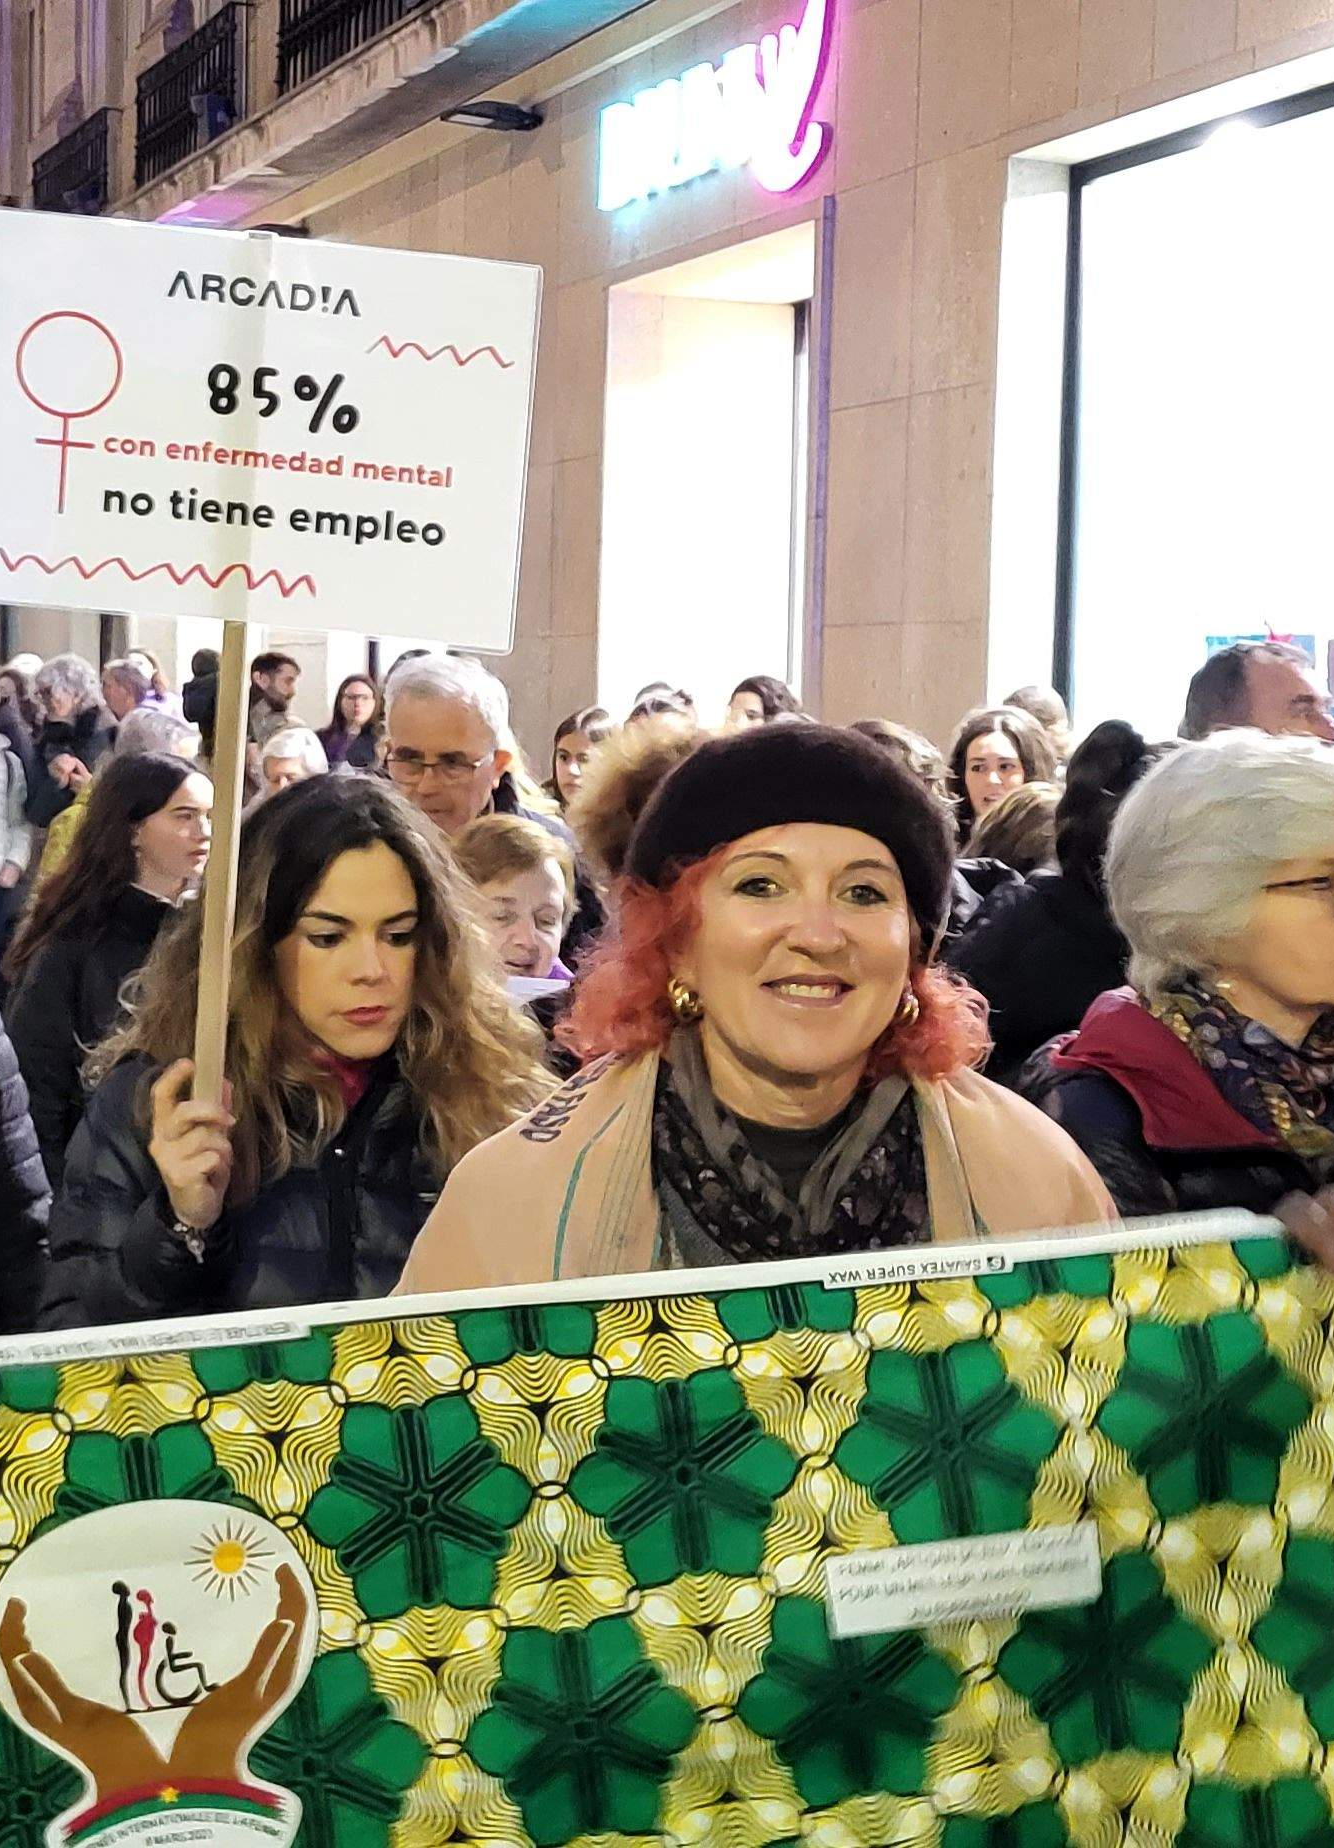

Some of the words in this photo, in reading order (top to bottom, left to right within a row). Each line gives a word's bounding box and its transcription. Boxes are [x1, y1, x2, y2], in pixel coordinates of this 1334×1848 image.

[205, 363, 361, 434] 85%
[103, 434, 156, 458] con
[165, 441, 344, 477] enfermedad
[351, 459, 453, 488] mental
[103, 488, 155, 517] no
[169, 487, 275, 529] tiene
[289, 506, 446, 547] empleo
[828, 1270, 862, 1284] WAX
[866, 1264, 916, 1280] SUPER
